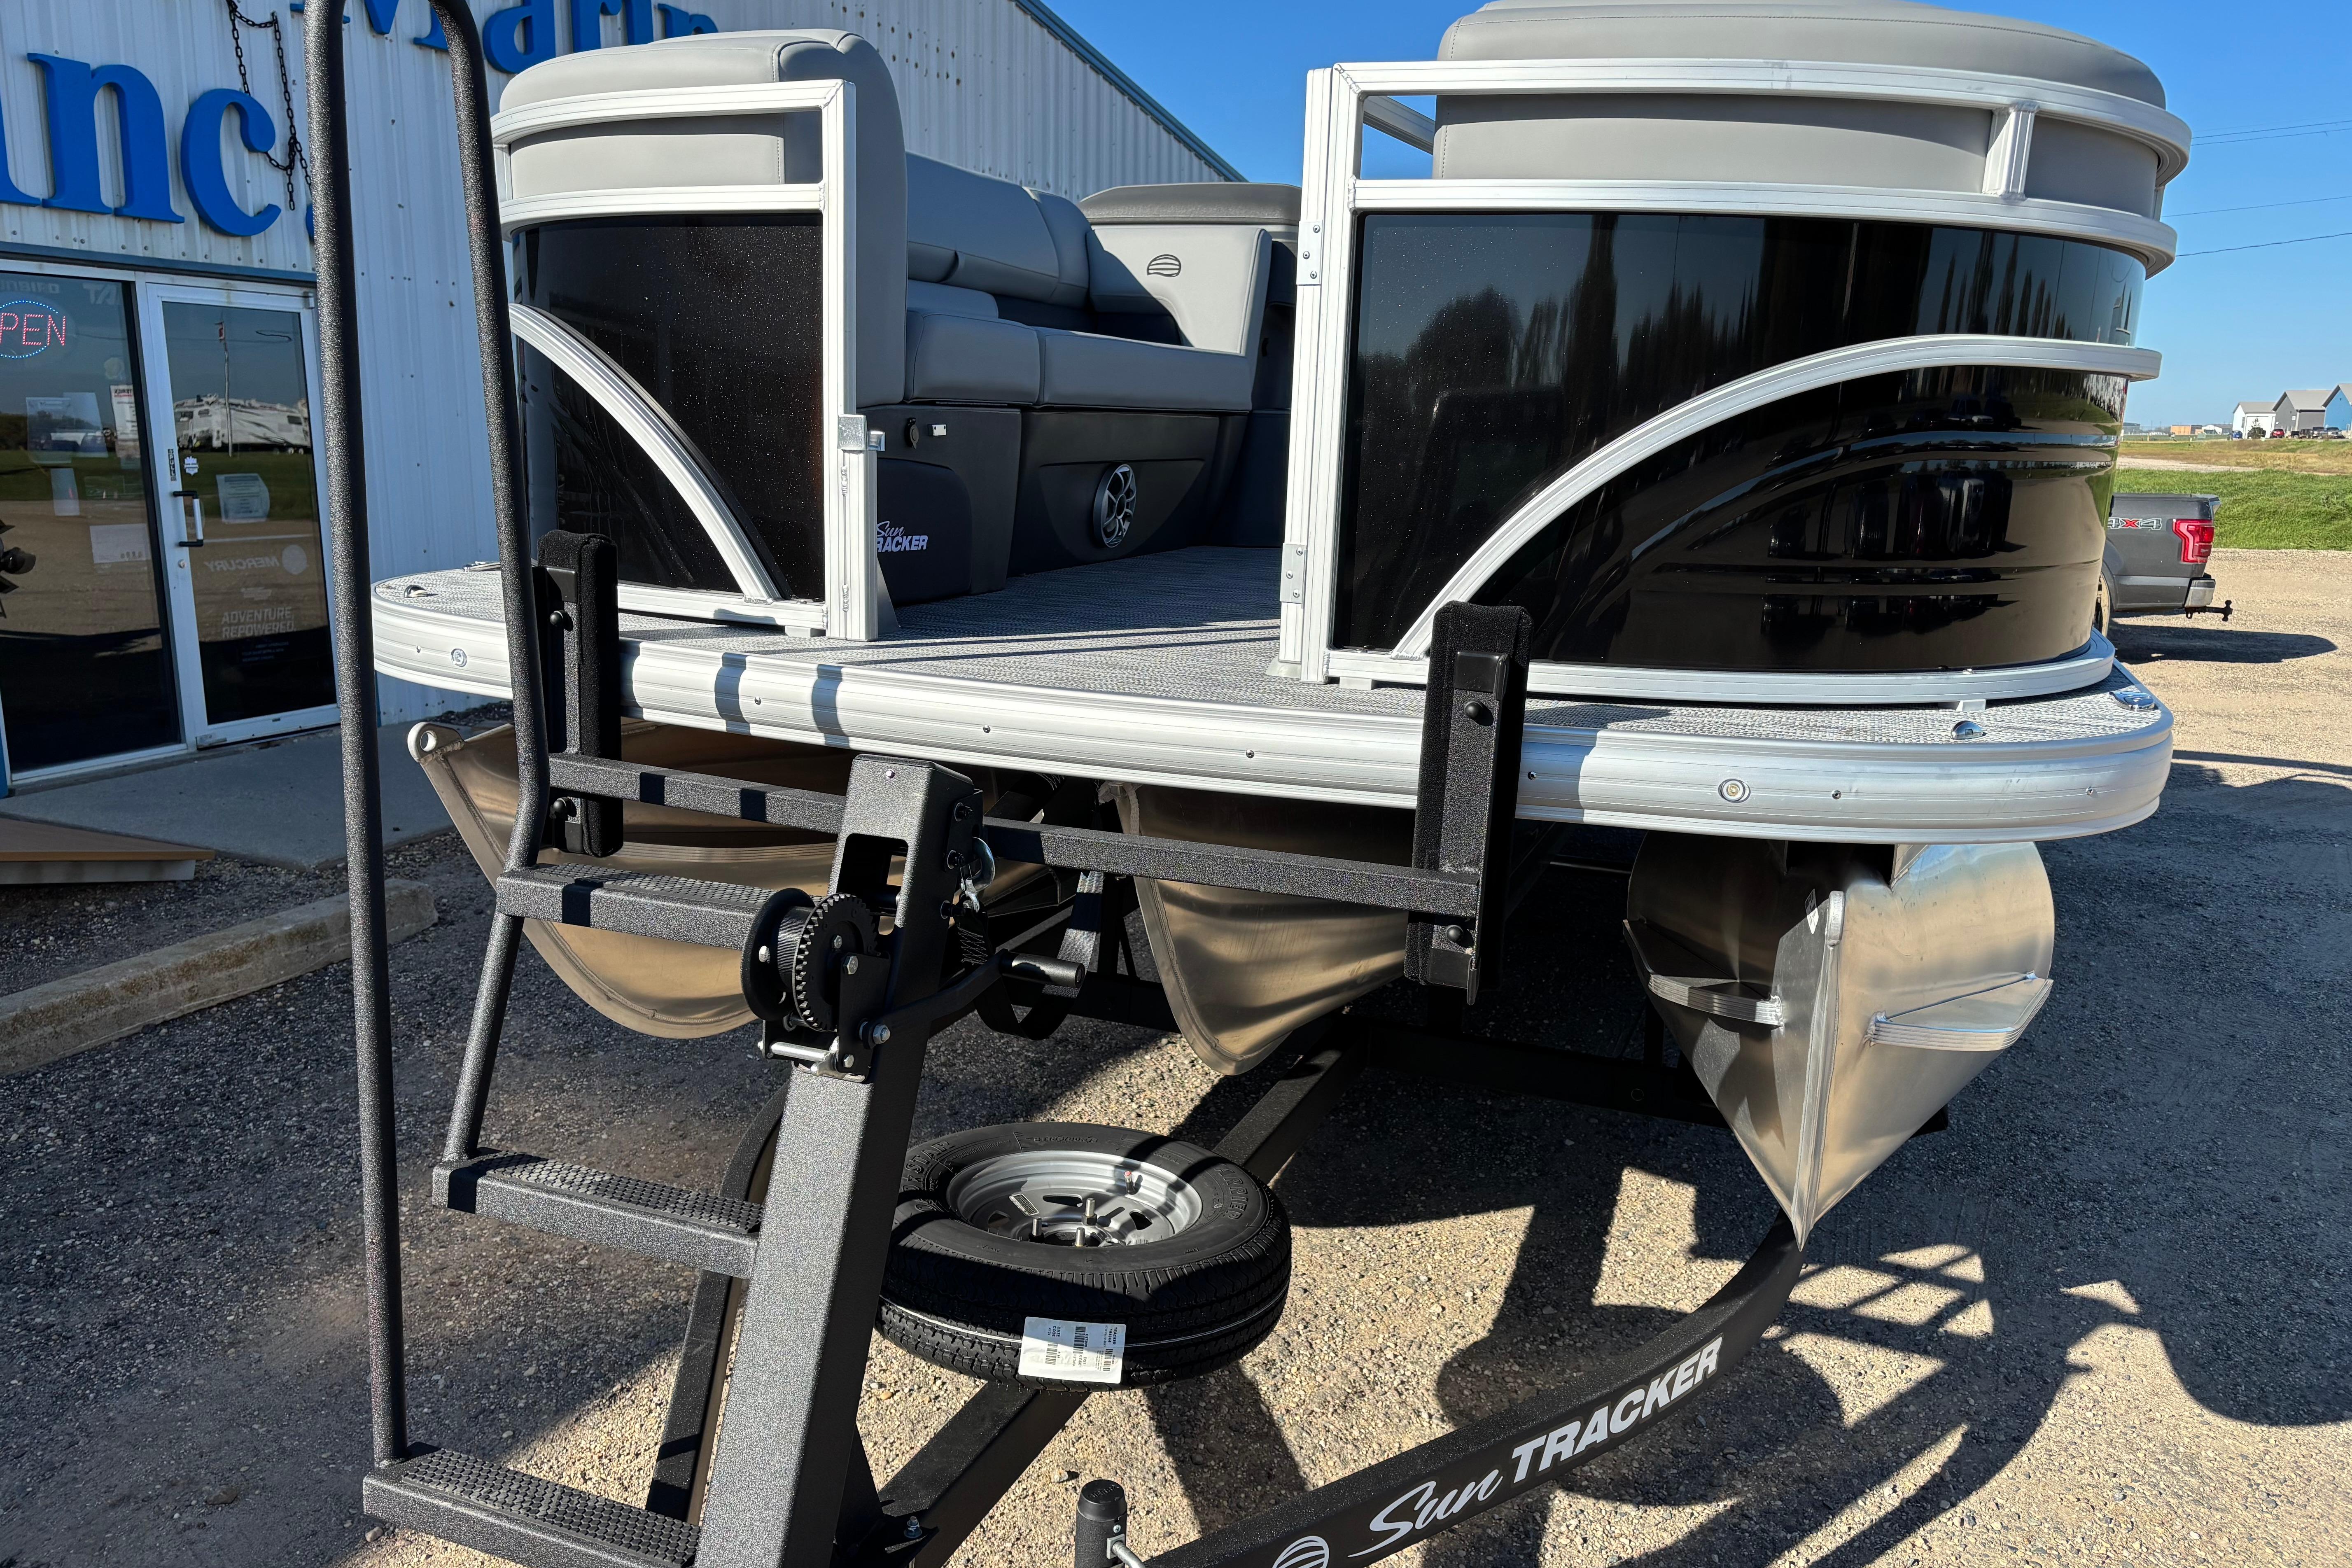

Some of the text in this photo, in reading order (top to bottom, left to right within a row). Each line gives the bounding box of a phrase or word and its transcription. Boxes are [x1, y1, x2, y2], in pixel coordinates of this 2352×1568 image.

[0, 313, 66, 346] PEN
[877, 521, 905, 537] Sun
[877, 535, 928, 552] RACKER
[1214, 1162, 1249, 1220] ARRIER
[1348, 1337, 1723, 1558] Sun TRACKER
